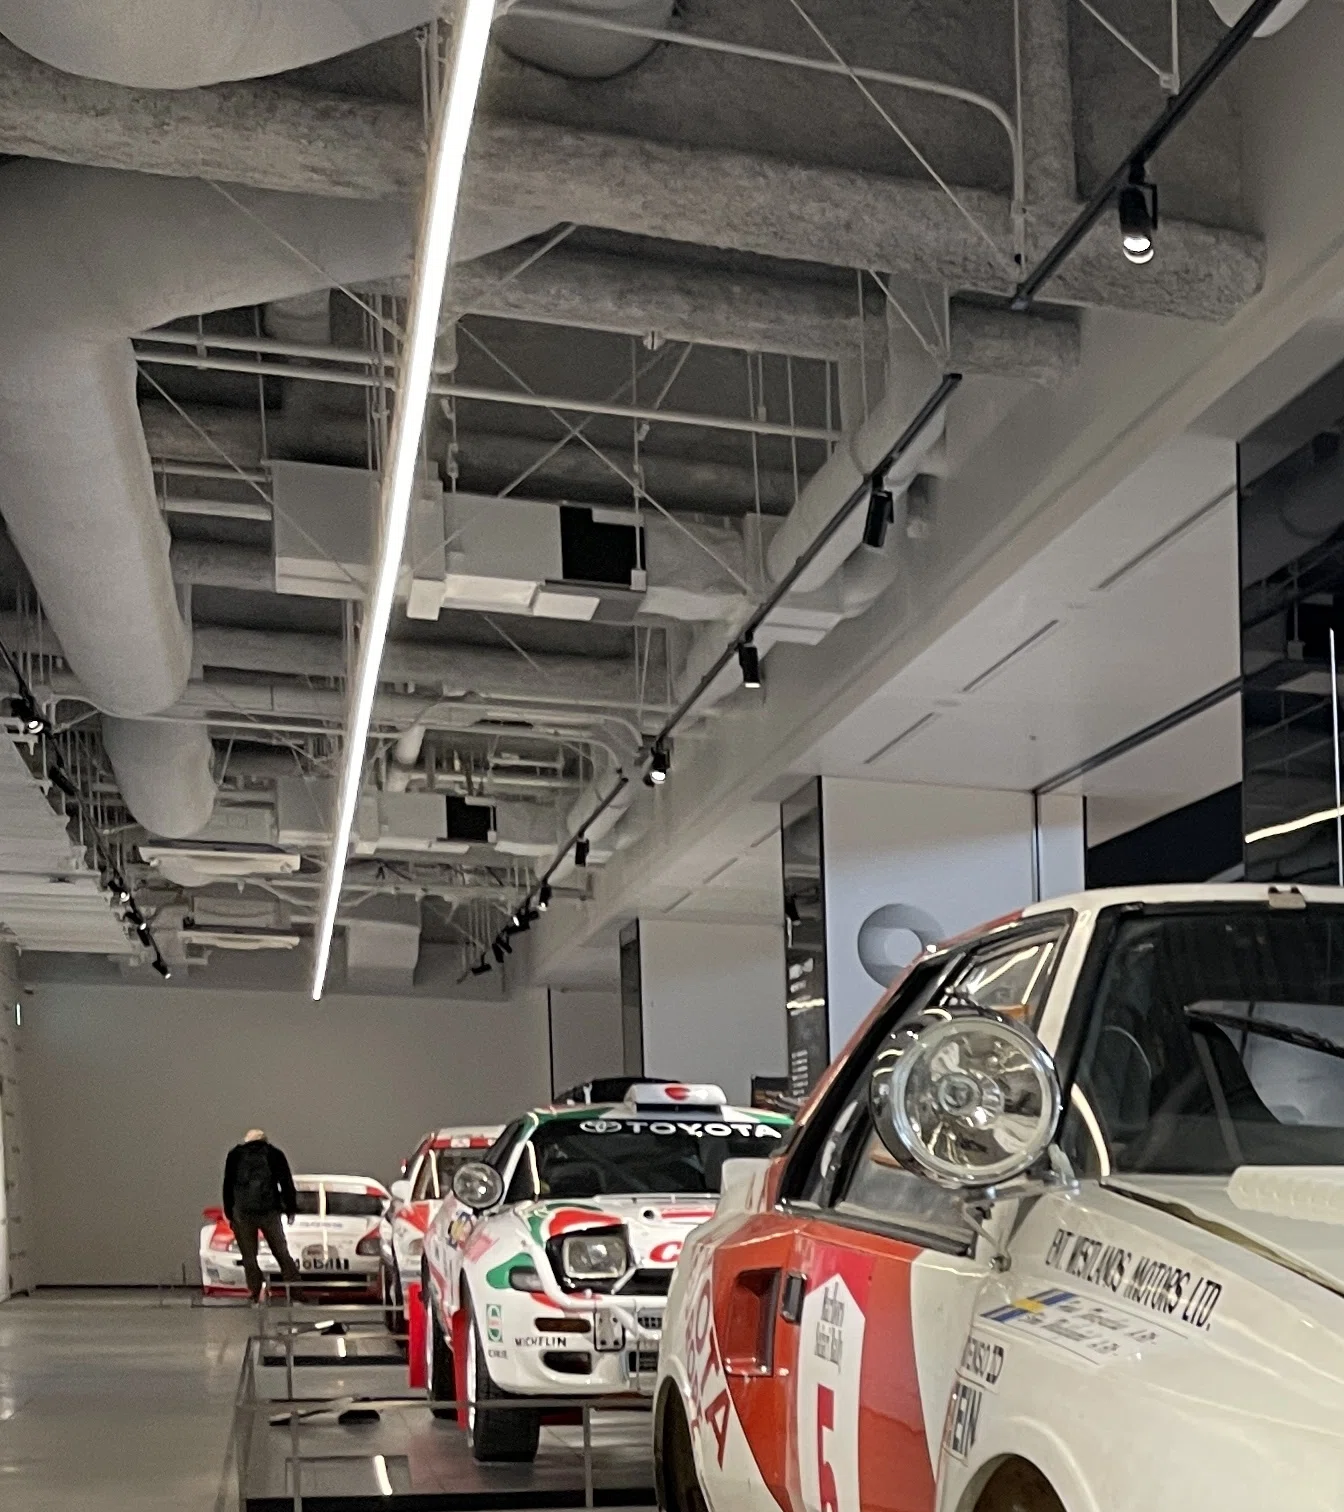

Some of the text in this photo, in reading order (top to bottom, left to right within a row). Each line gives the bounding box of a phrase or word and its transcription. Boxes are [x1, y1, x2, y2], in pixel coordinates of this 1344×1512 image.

[628, 1120, 782, 1139] TOYOTA
[1123, 1255, 1191, 1314] MOTORS
[1182, 1276, 1223, 1332] LTD.
